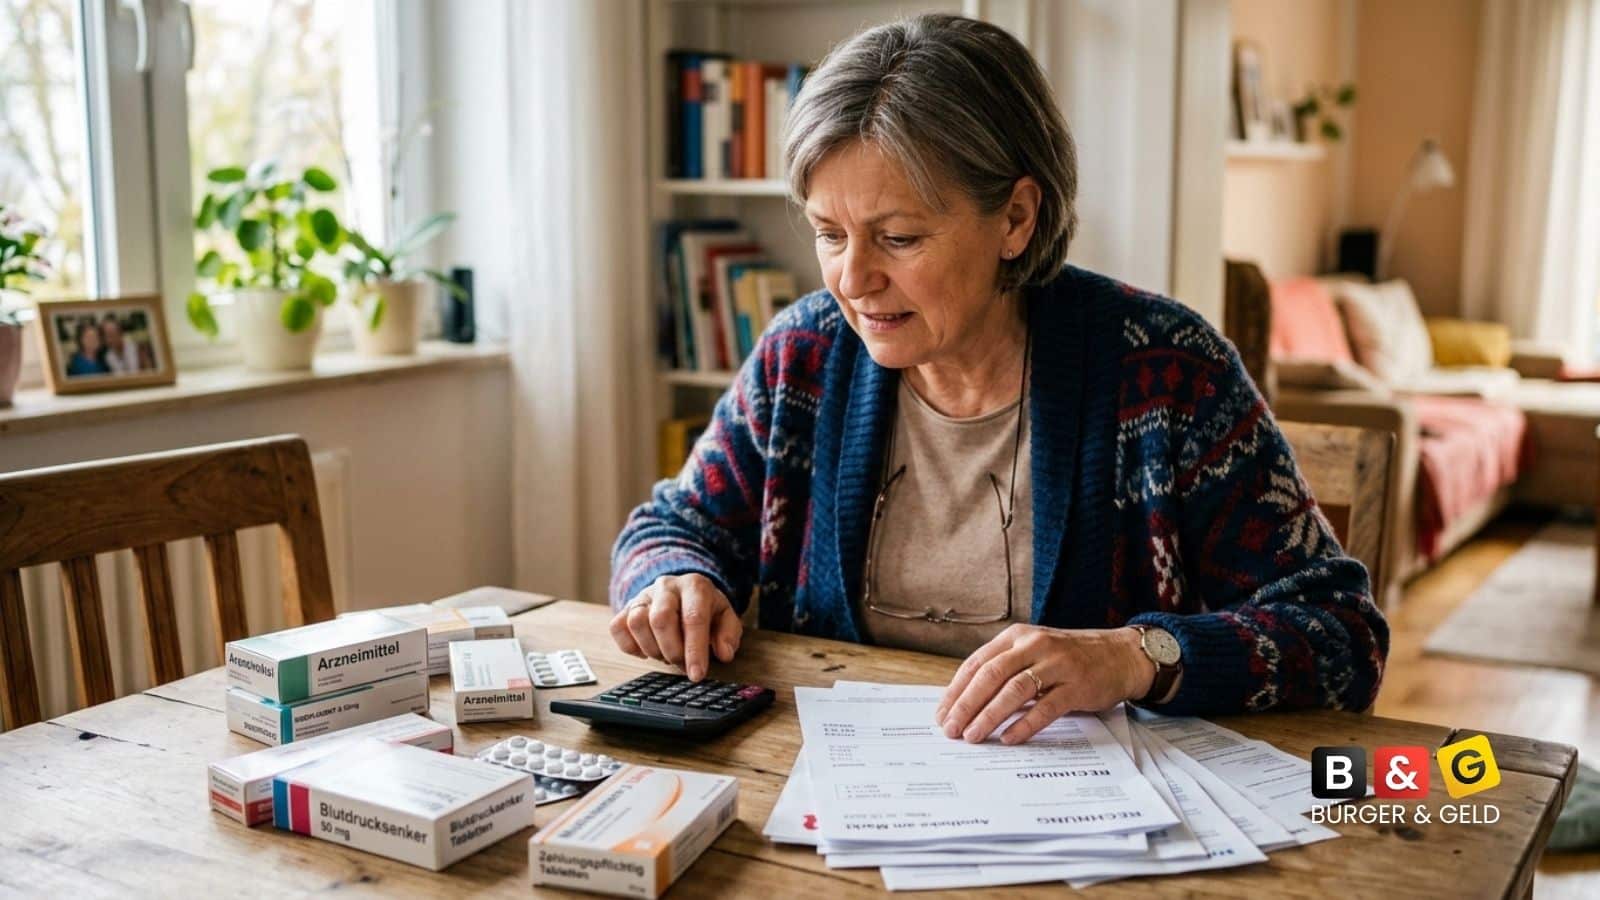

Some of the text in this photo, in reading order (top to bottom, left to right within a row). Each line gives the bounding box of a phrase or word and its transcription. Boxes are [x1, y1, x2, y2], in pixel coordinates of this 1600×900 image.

[317, 640, 400, 671] Arzneimittel
[1016, 768, 1111, 780] RECHNUNG
[320, 801, 429, 844] Blutdrucksenker
[1036, 809, 1142, 825] RECHNUNG
[320, 820, 351, 841] 50 mg
